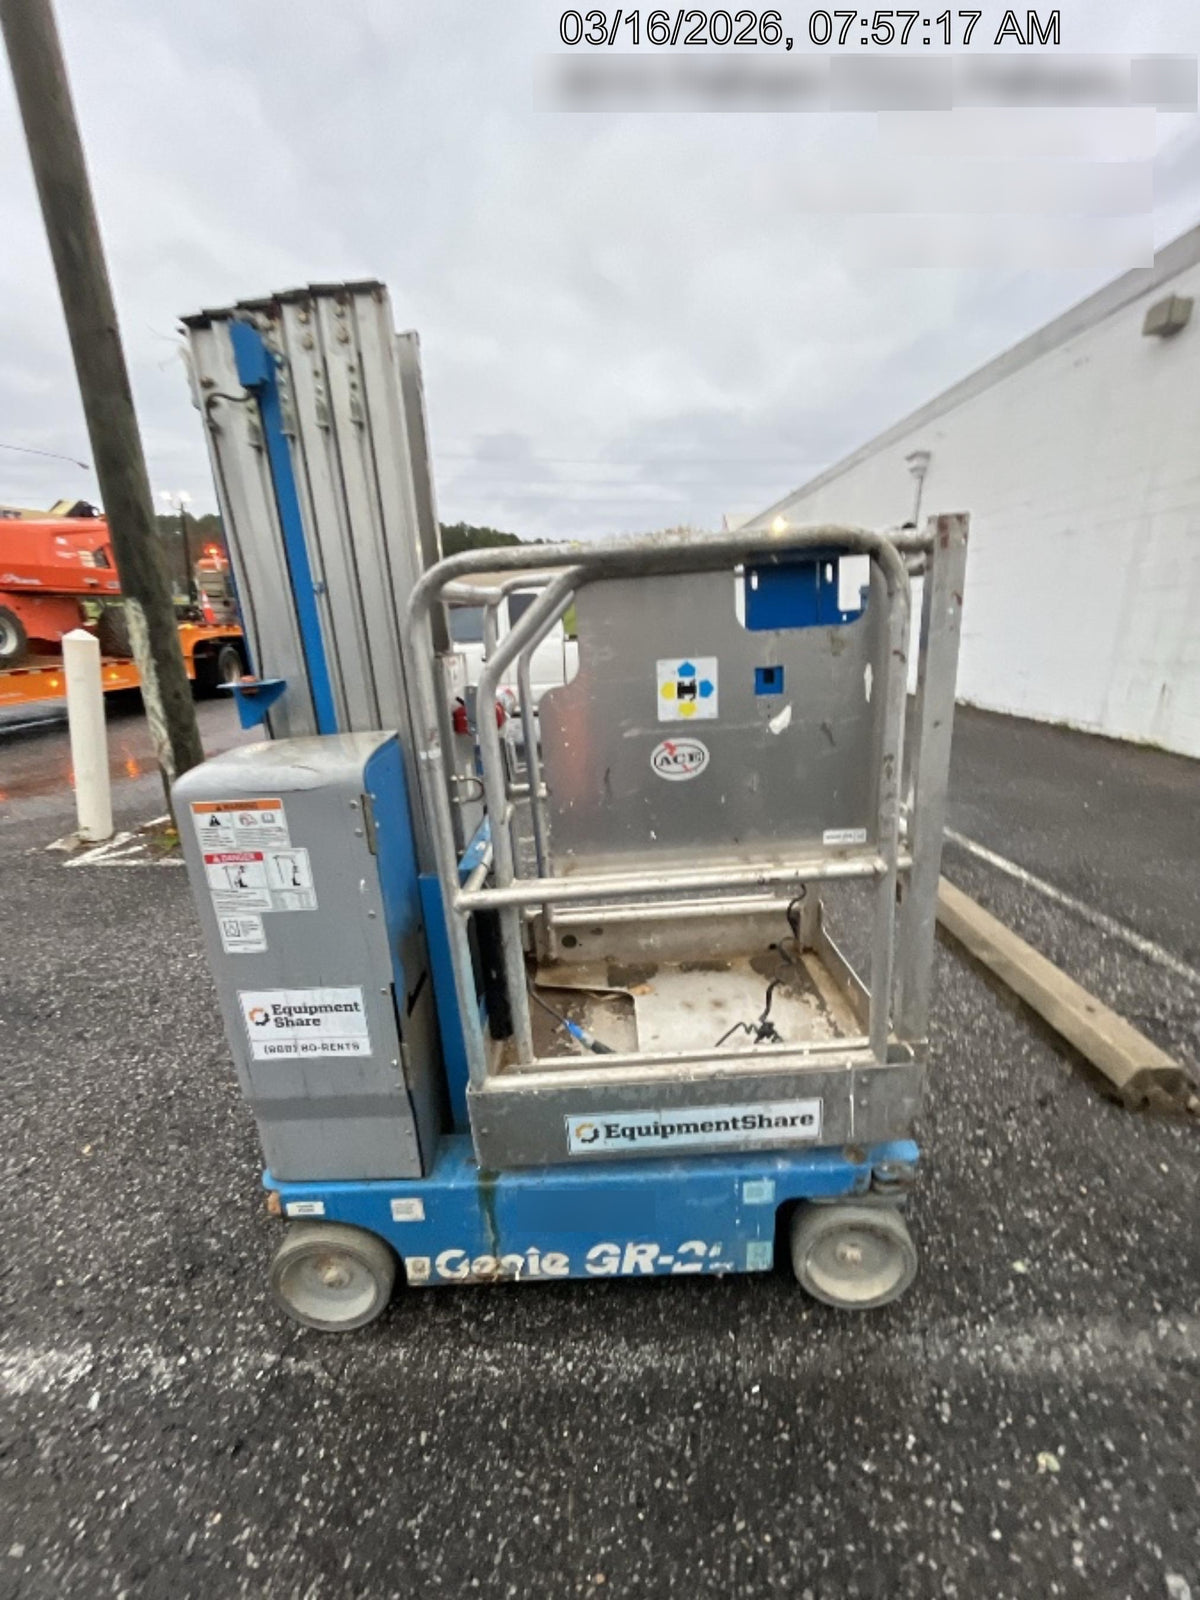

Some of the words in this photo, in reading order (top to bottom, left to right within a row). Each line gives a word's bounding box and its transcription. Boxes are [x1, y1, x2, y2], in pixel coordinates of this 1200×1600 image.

[658, 750, 703, 767] ACE
[271, 1001, 361, 1016] Equipment
[273, 1016, 321, 1028] Share
[604, 1113, 815, 1140] EquipmentShare
